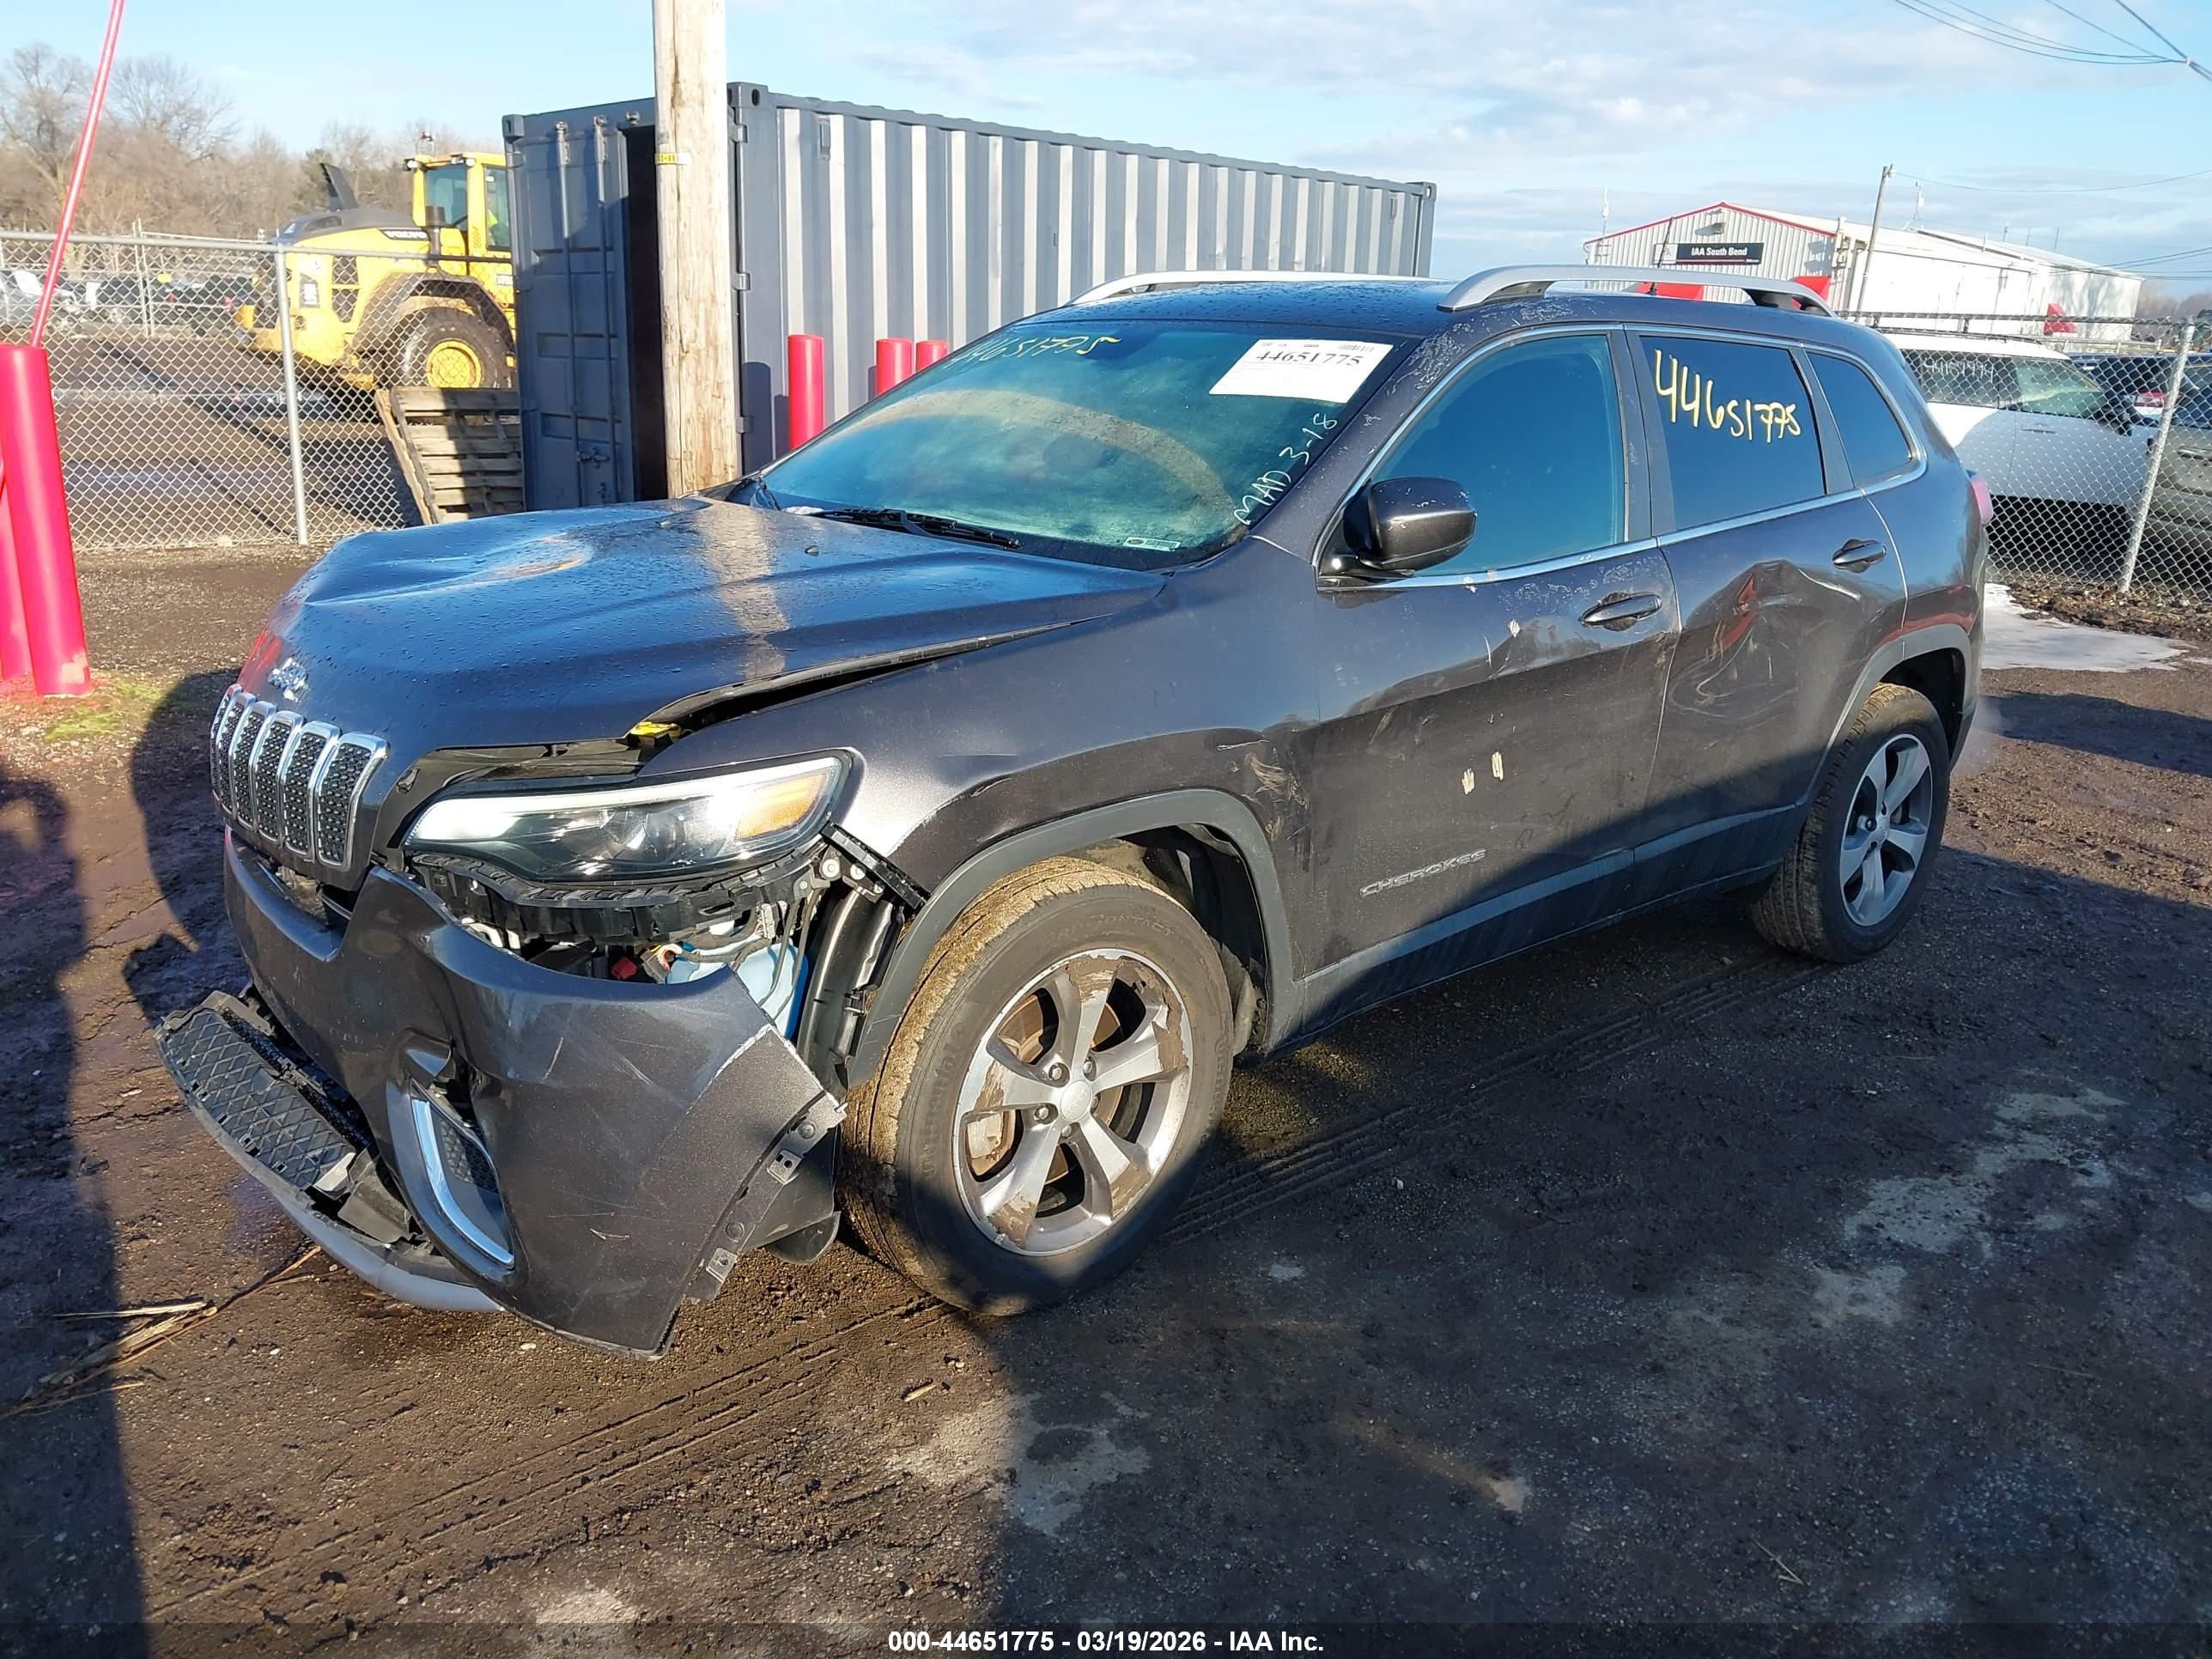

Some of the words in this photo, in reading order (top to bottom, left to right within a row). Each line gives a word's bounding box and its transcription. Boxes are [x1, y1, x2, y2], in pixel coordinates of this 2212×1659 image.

[1691, 246, 1705, 256] IAA
[1706, 246, 1727, 256] South
[1728, 246, 1747, 256] Bend
[1255, 350, 1364, 367] 44651775
[1654, 349, 1802, 444] 44651775
[1233, 470, 1291, 526] MAD
[1278, 412, 1338, 465] 3-18
[1359, 848, 1487, 899] CHEROKEE
